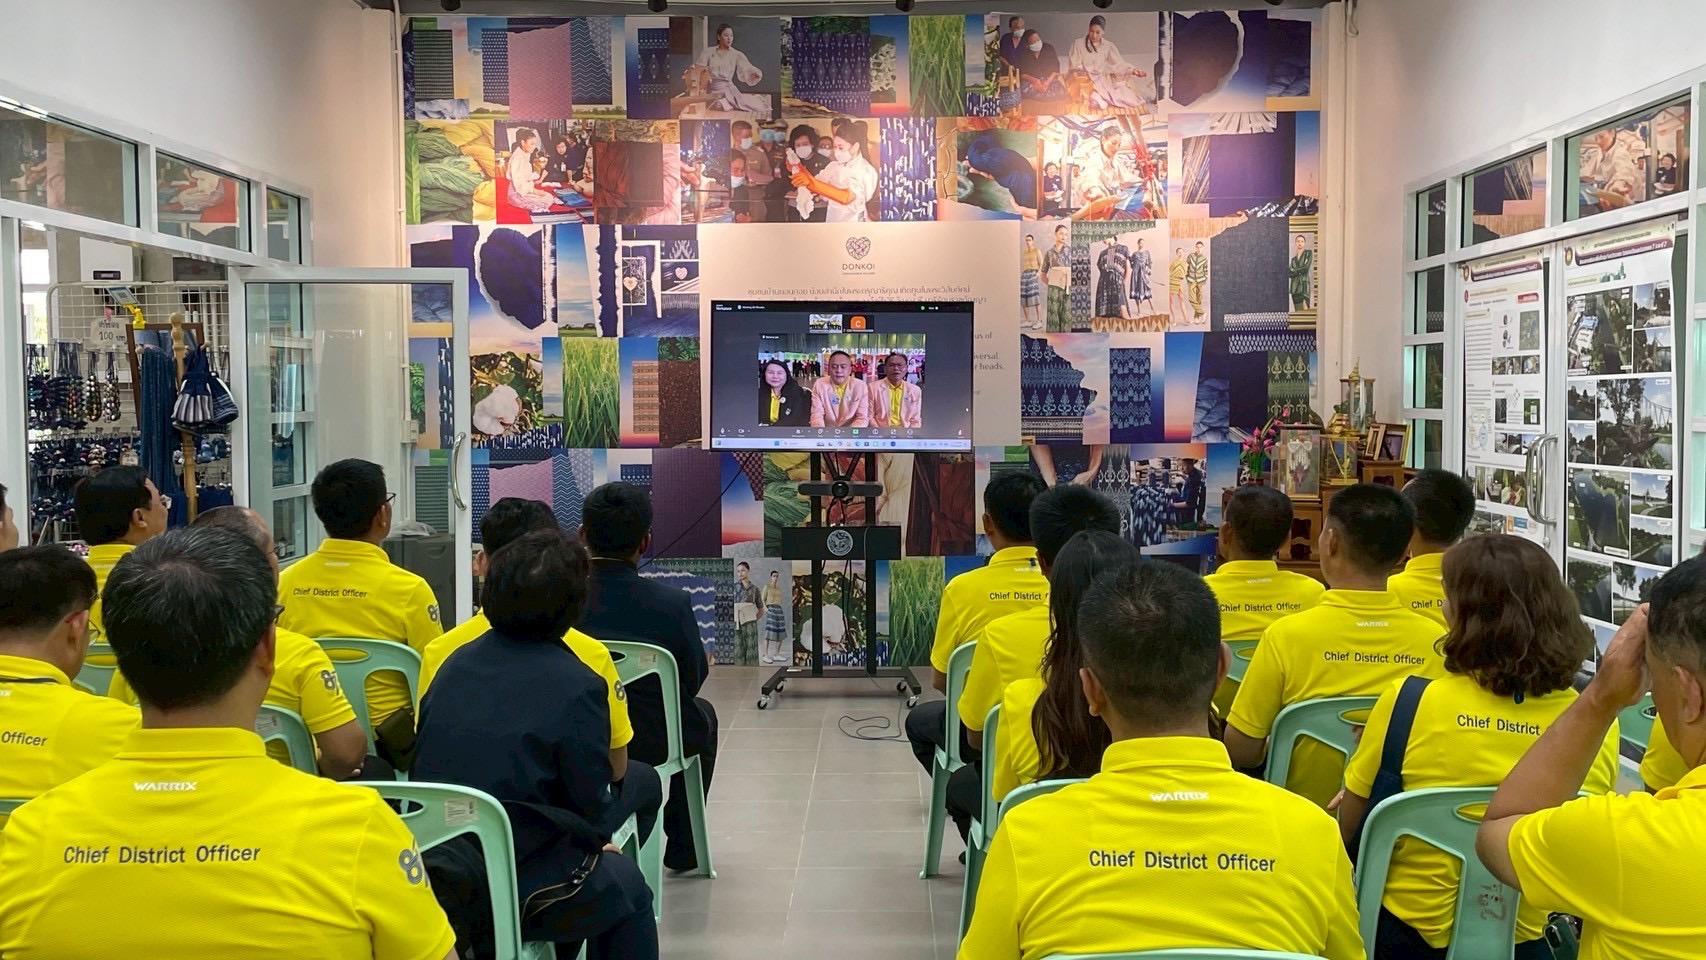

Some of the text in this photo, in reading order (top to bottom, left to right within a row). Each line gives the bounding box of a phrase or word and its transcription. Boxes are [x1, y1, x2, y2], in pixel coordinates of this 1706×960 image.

[98, 331, 114, 341] 100
[985, 331, 993, 340] of
[293, 587, 368, 598] Chief District Officer
[989, 592, 1010, 600] Chief
[1014, 592, 1041, 600] District
[1219, 603, 1302, 612] Chief District Officer
[1411, 599, 1433, 609] Chief
[1324, 651, 1425, 665] Chief District Officer
[1457, 714, 1541, 736] Chief District
[1, 731, 48, 747] Officer
[134, 781, 198, 792] WARRIX
[1149, 791, 1210, 802] WARRIX
[64, 845, 261, 864] Chief District Officer
[1089, 850, 1276, 873] Chief District Officer
